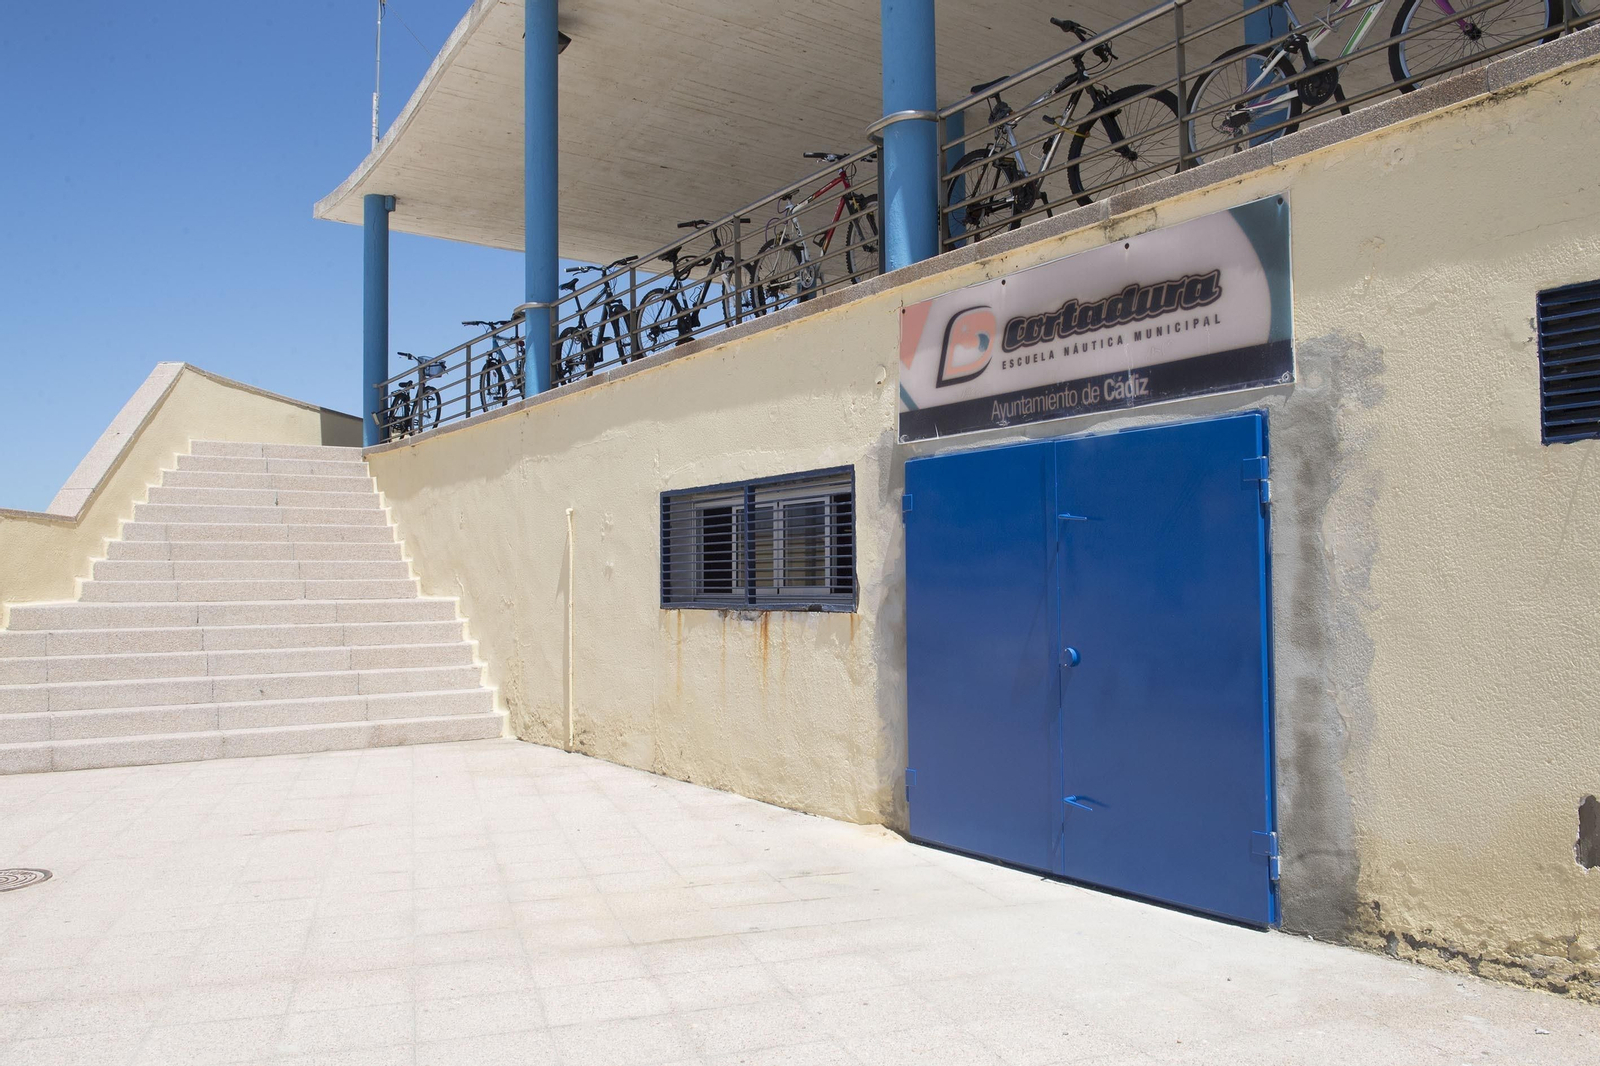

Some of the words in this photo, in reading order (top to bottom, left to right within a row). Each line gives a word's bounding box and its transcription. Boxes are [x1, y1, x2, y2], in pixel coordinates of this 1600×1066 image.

[1002, 350, 1055, 370] ESCUELA
[1063, 335, 1123, 356] NÁUTICA
[1134, 314, 1221, 341] MUNICIPAL
[991, 388, 1078, 422] Ayuntamiento
[1081, 383, 1100, 405] de
[1104, 374, 1149, 401] Cádiz
